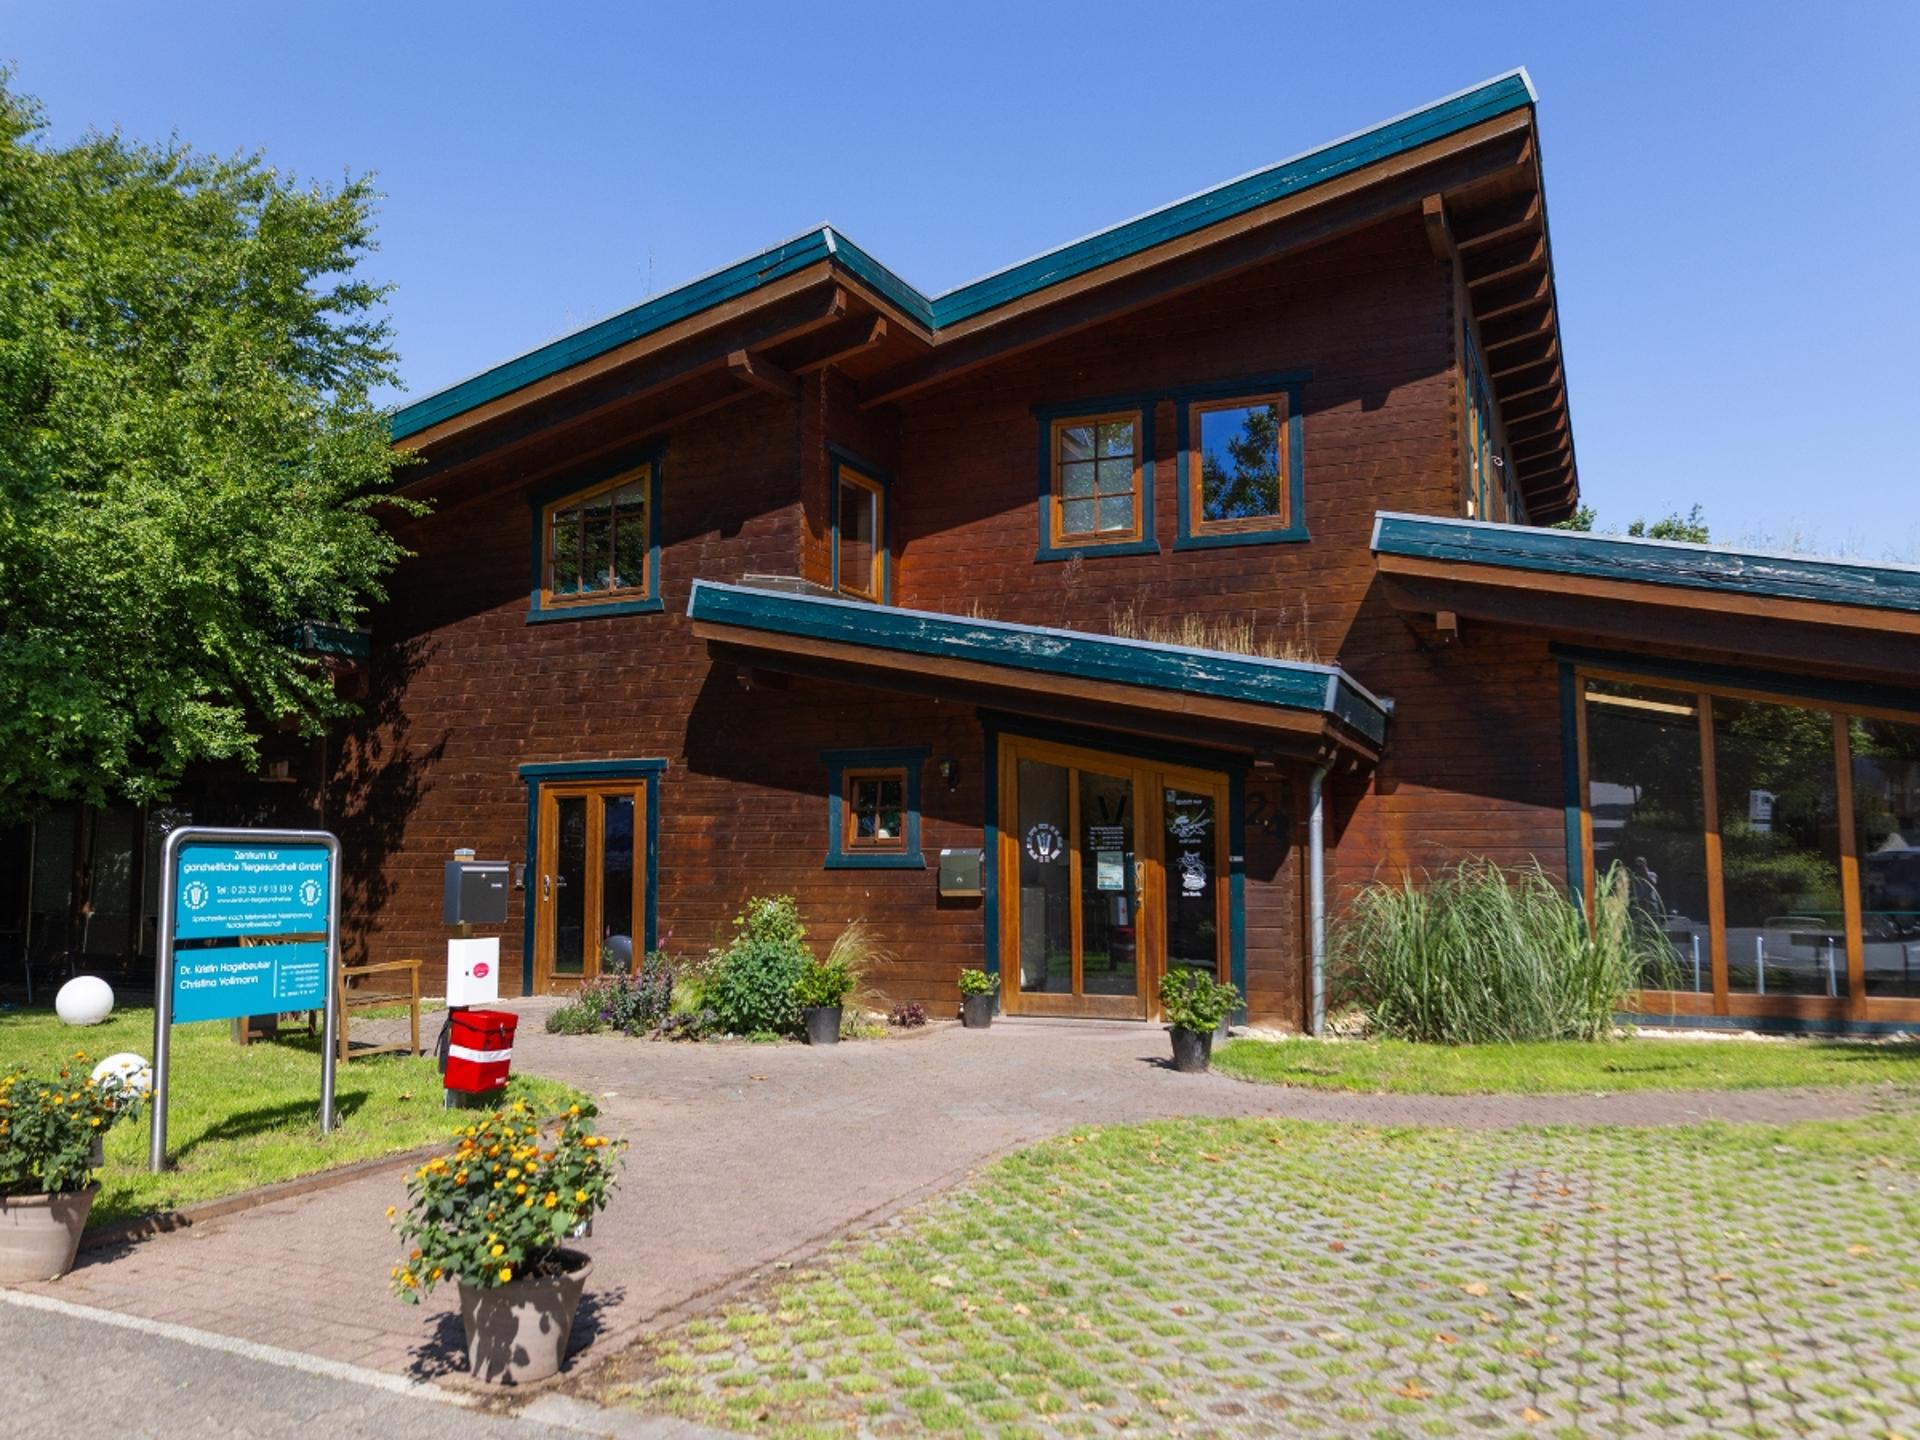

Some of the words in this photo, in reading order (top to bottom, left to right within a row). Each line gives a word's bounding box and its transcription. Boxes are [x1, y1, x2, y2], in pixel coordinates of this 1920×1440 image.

[234, 851, 266, 860] Zentrum
[268, 850, 278, 860] für
[184, 863, 239, 874] ganzheitliche
[241, 862, 297, 873] Tiergesundheit
[298, 862, 322, 872] GmbH
[180, 966, 192, 975] Dr.
[195, 964, 218, 973] Kristin
[180, 978, 217, 990] Christina
[219, 975, 259, 986] Vollmann
